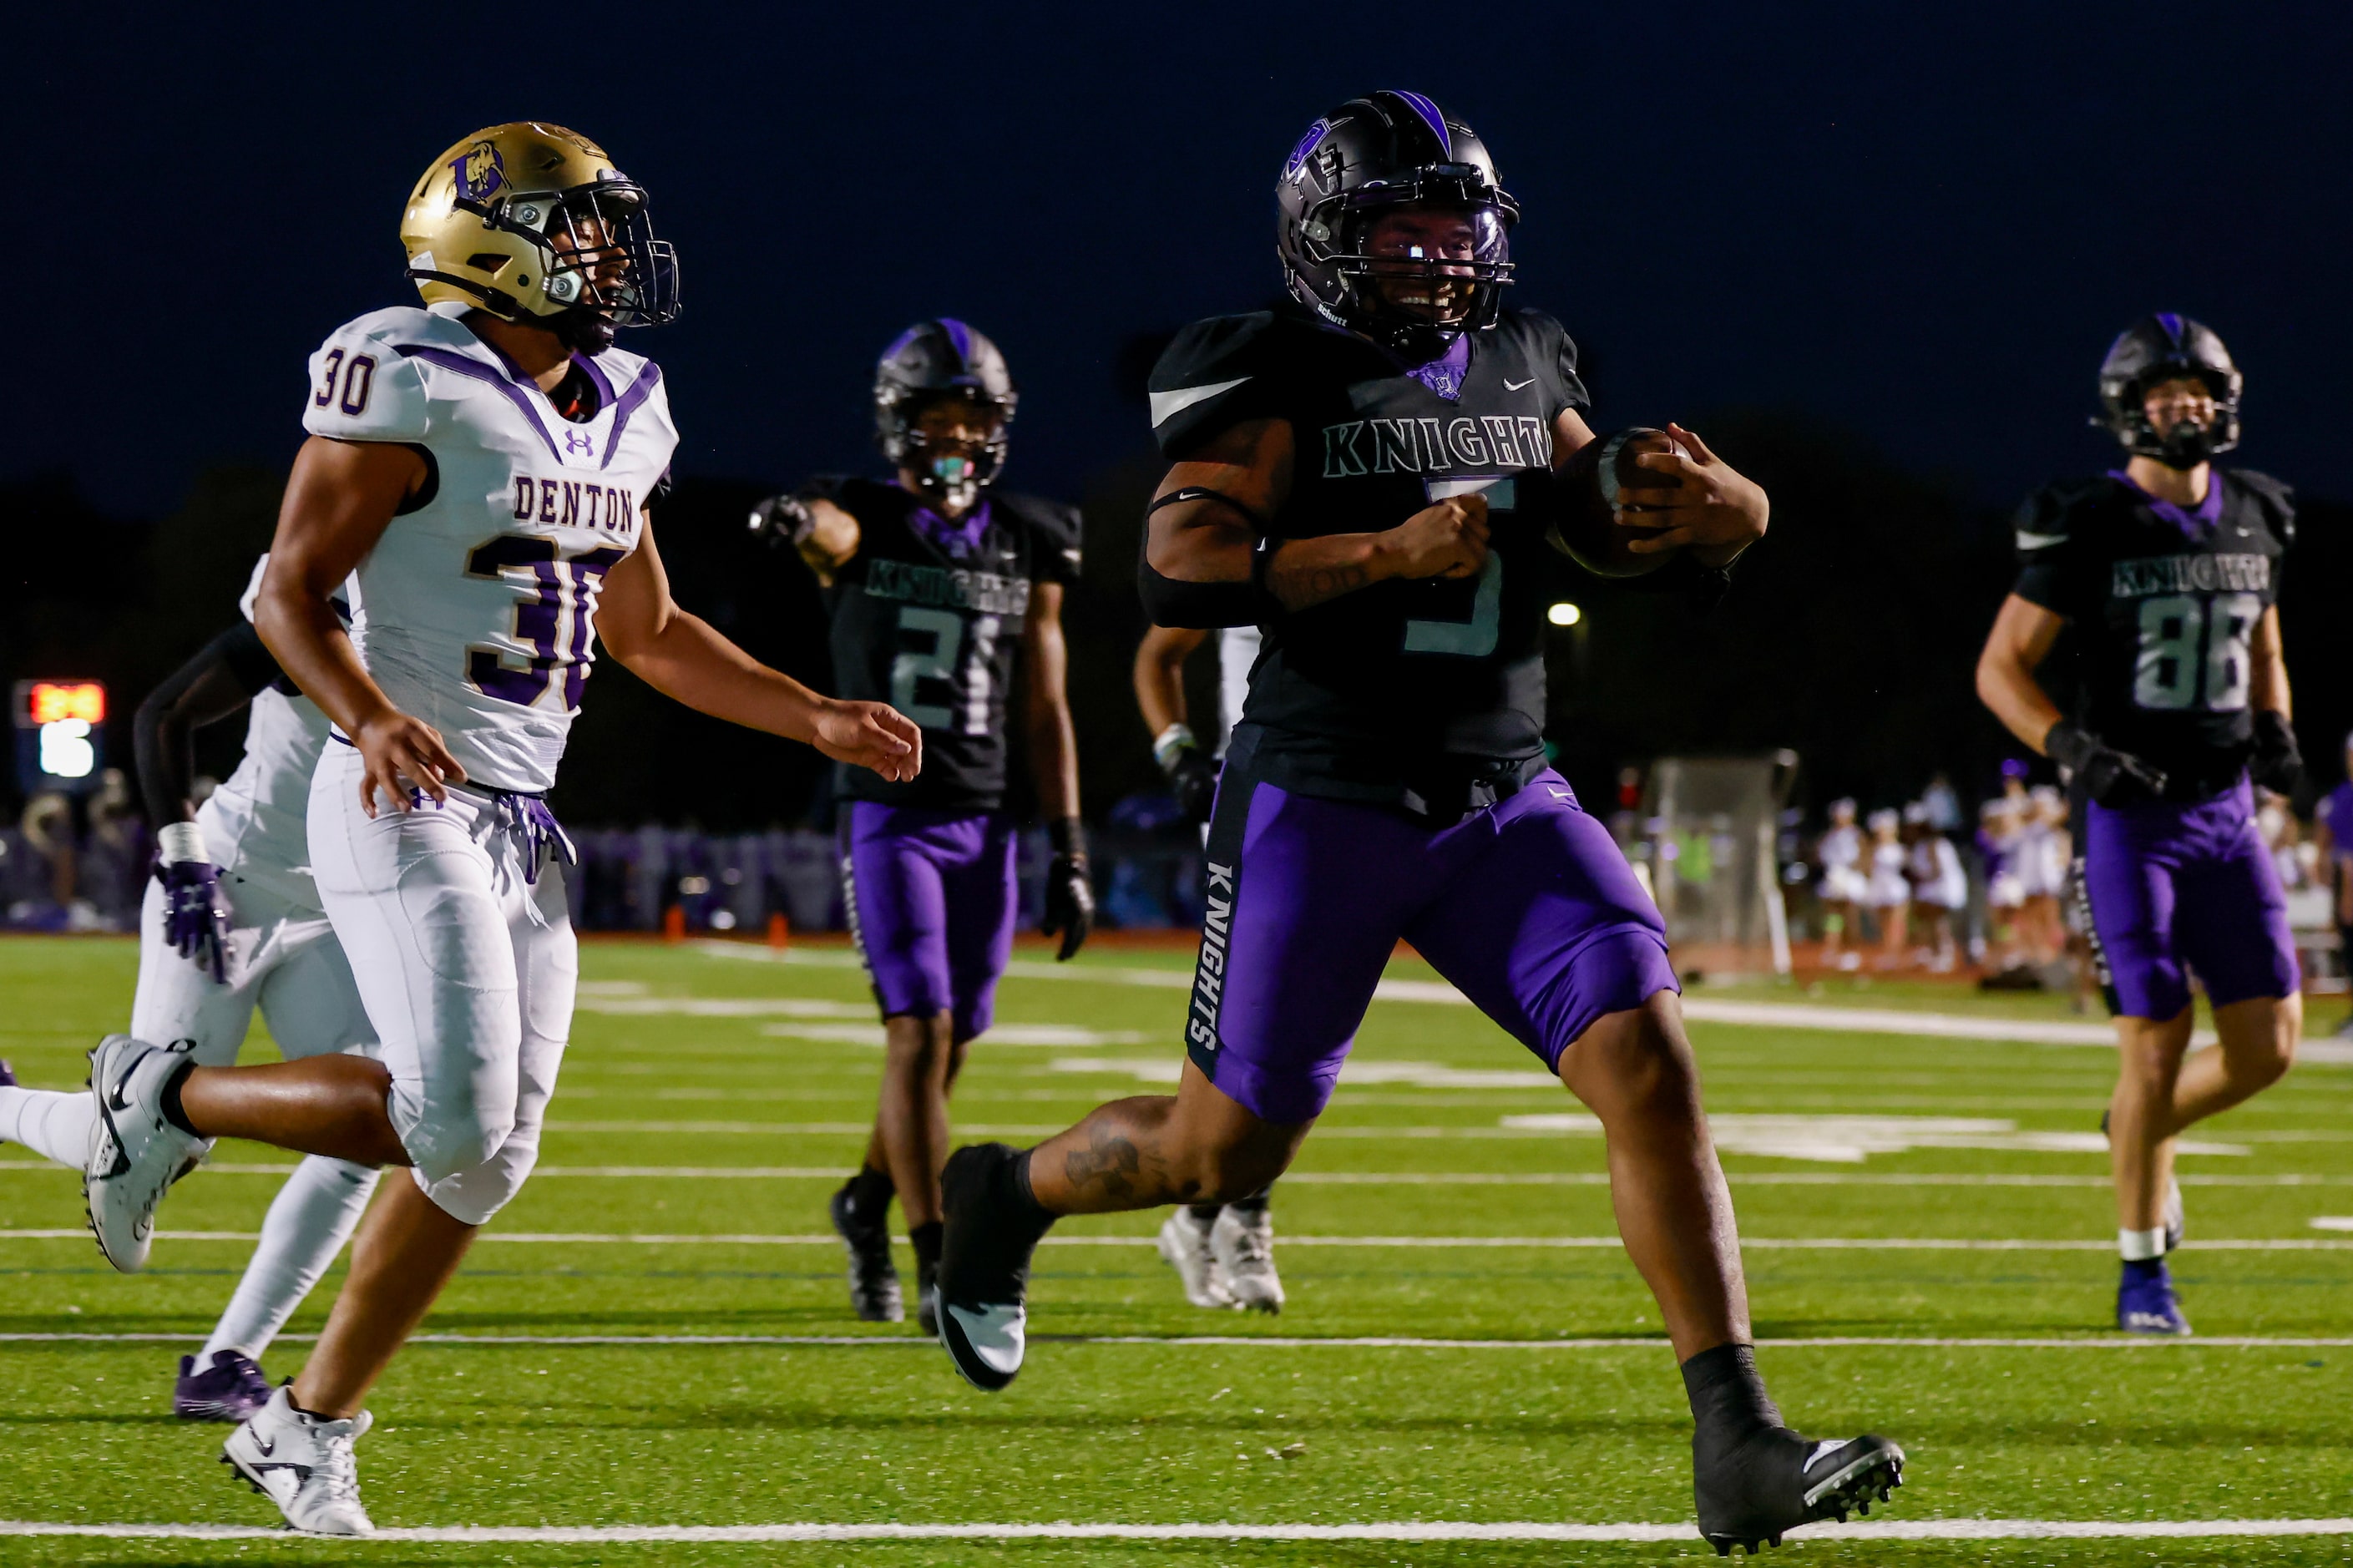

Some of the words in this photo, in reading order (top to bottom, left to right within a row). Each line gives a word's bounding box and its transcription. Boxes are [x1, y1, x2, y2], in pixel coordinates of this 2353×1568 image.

[1317, 302, 1348, 327] schutt
[316, 346, 378, 417] 30
[514, 476, 632, 533] DENTON
[1404, 475, 1516, 656] 5
[891, 608, 1000, 736] 21
[1191, 862, 1232, 1052] KNIGHTS
